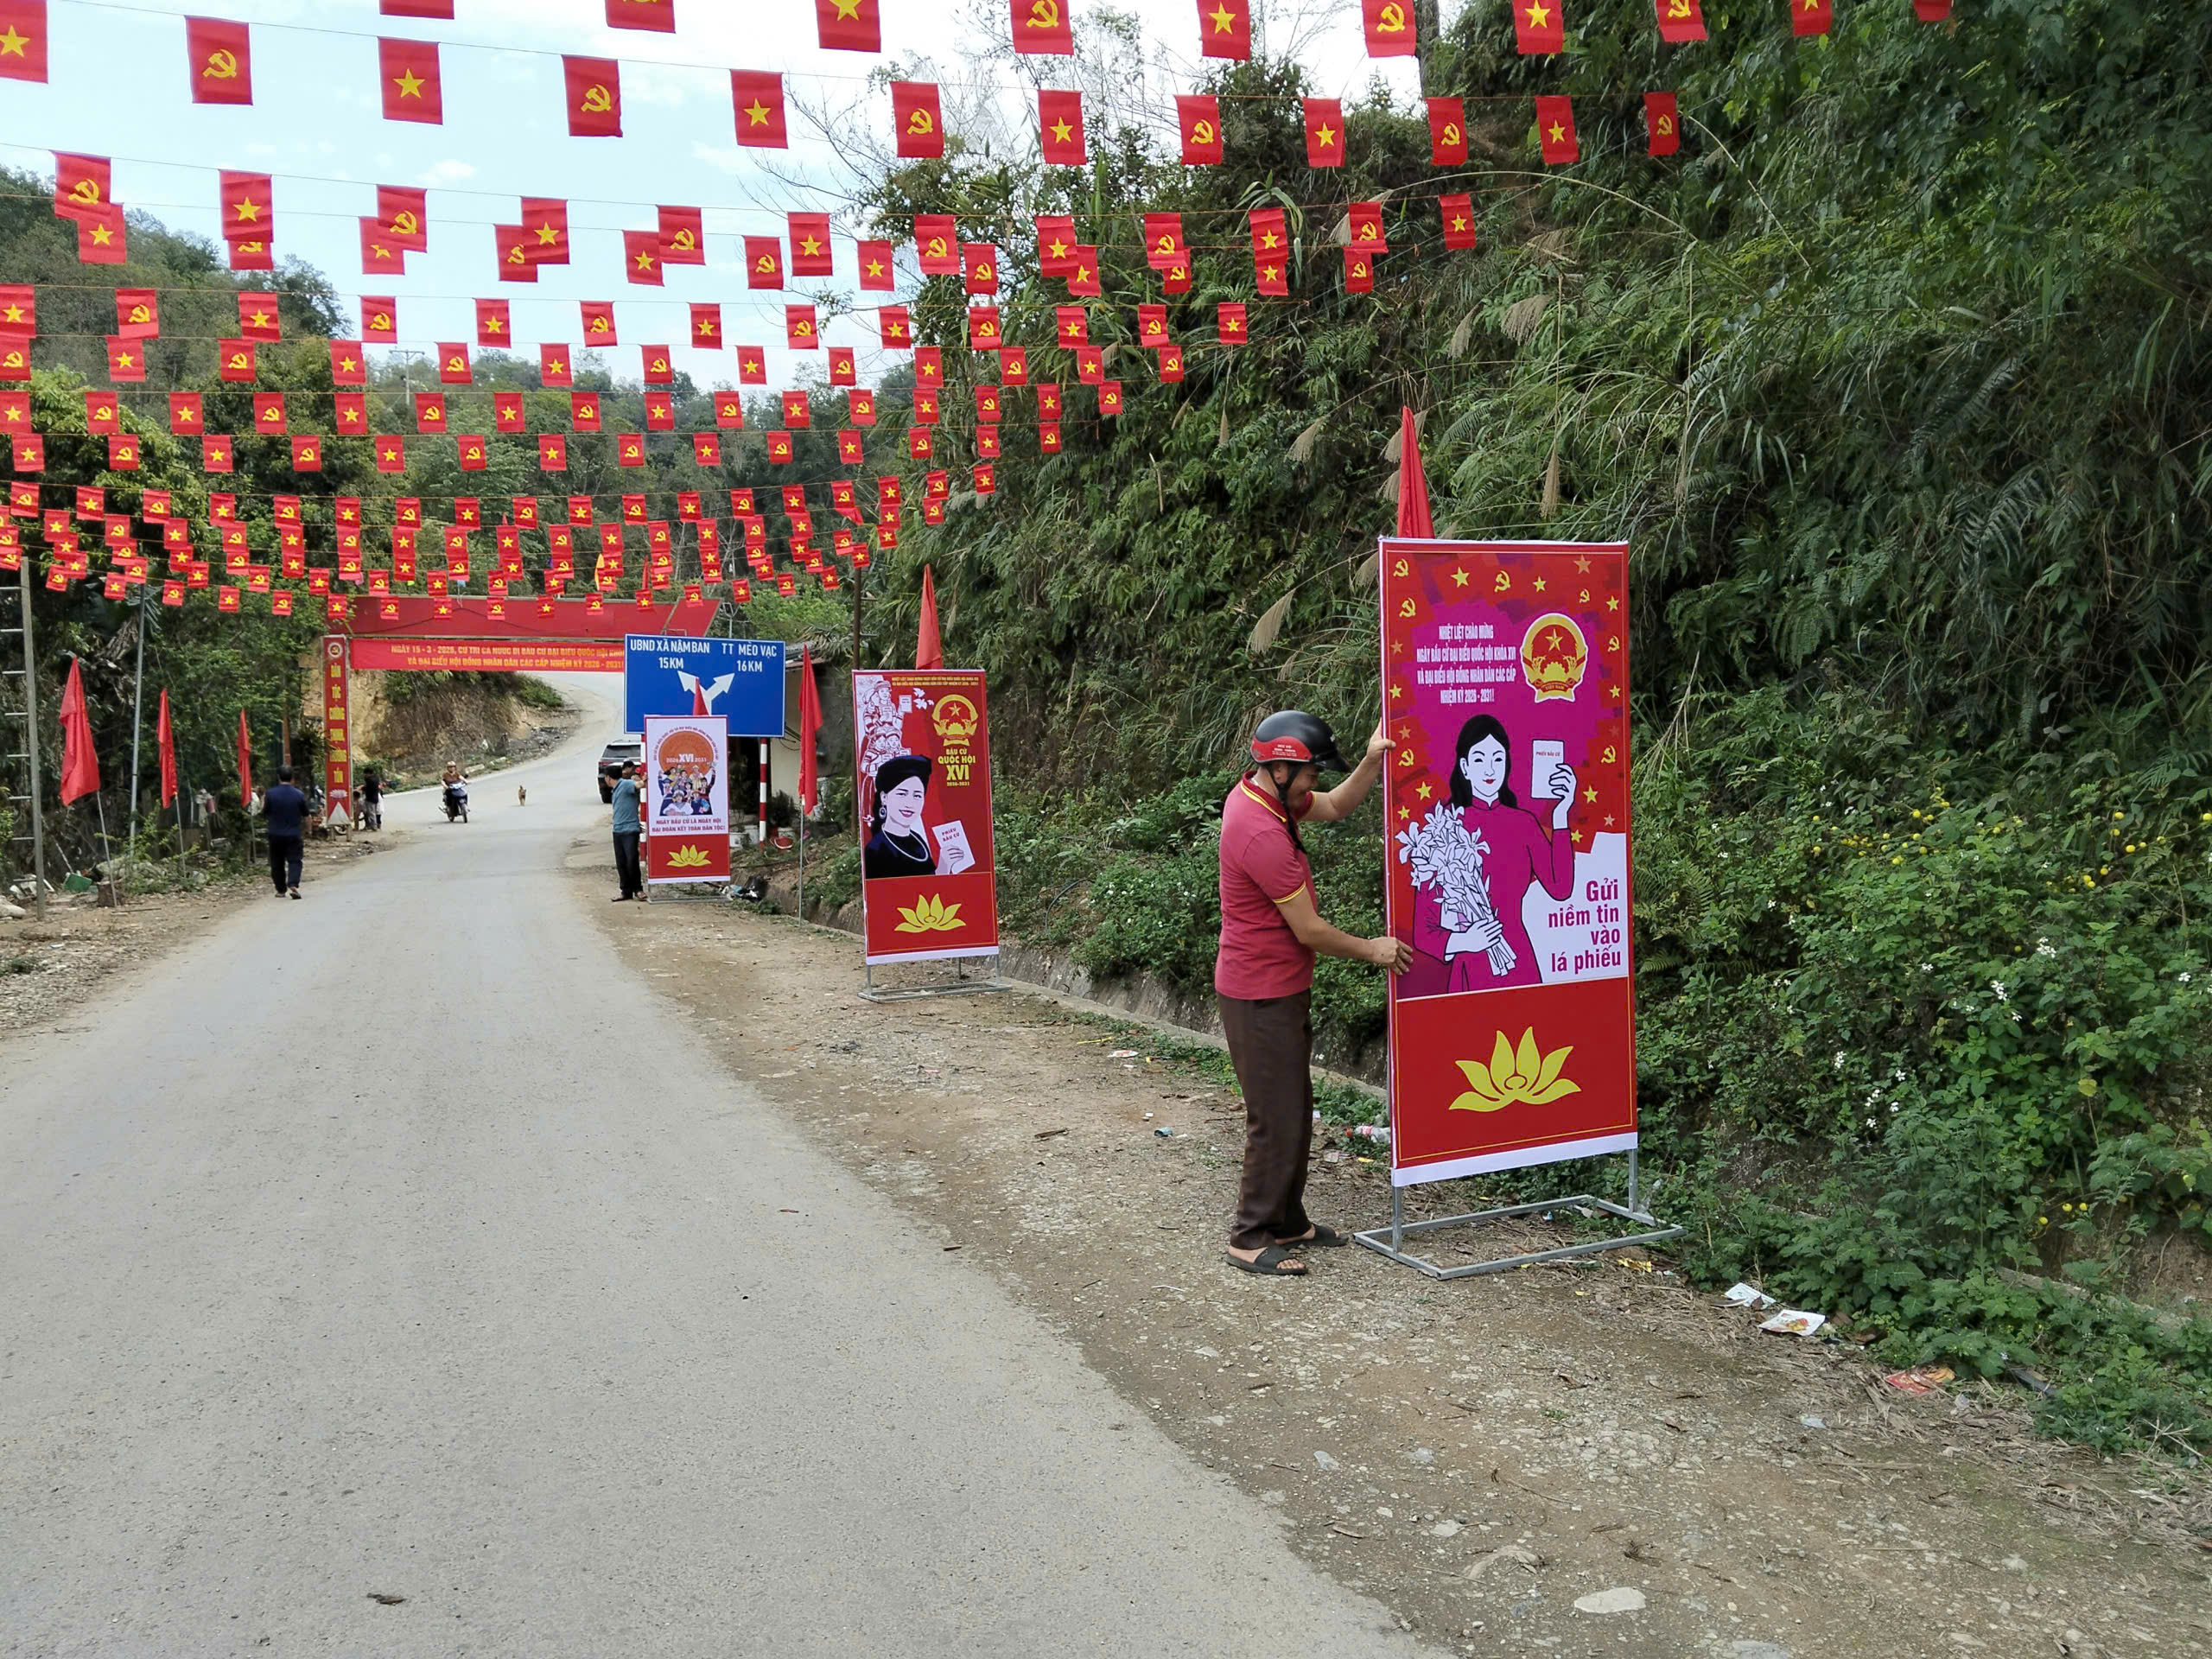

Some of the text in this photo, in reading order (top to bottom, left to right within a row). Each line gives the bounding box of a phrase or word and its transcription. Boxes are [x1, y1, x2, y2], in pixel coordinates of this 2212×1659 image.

[1454, 622, 1465, 642] LIỆT
[412, 645, 421, 654] 15
[630, 638, 778, 659] UBND XÃ NẬM BAN TT MÈO VẠC
[678, 753, 694, 763] XVI
[938, 753, 976, 766] QUỐC HỘI
[946, 765, 969, 780] XVI
[1586, 877, 1618, 902] Gửi
[1548, 903, 1619, 928] niềm tin
[1590, 925, 1620, 945] vào
[1551, 944, 1621, 975] lá phiếu
